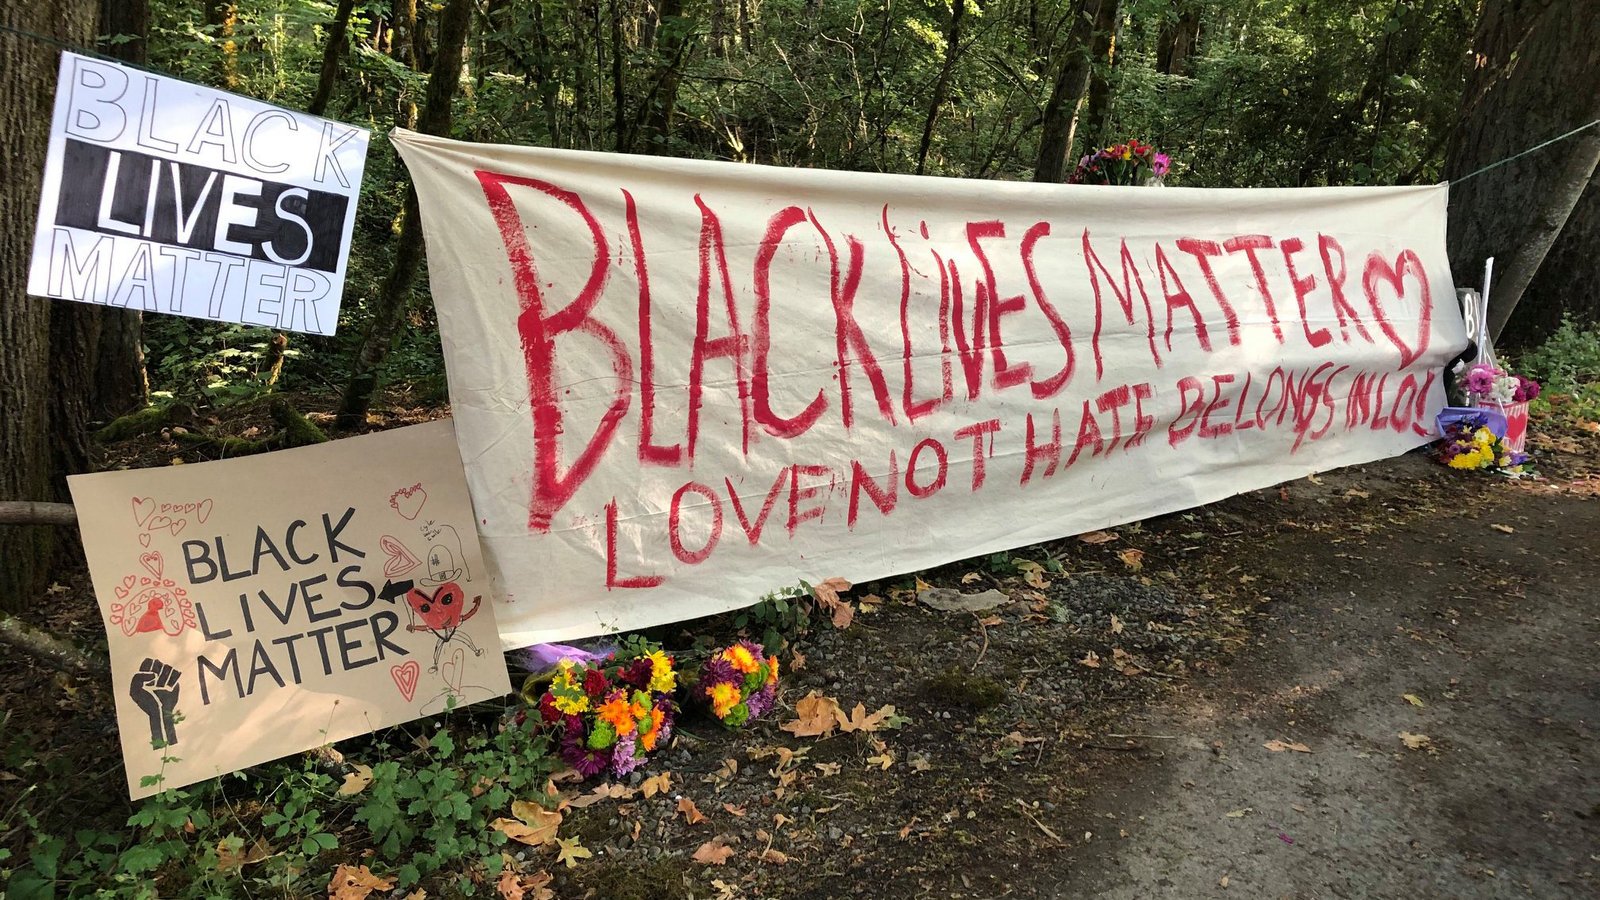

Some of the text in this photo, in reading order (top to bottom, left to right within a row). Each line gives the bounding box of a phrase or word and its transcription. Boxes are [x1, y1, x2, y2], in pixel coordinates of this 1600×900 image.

[65, 57, 359, 188] BLACK
[97, 150, 314, 267] LIVES
[47, 227, 331, 334] MATTER
[474, 169, 1375, 534] BLACK LIVES MATTER
[605, 462, 836, 591] LOVE
[847, 418, 1002, 532] NOT
[1019, 382, 1156, 487] HATE
[1168, 361, 1350, 455] BELONGS
[1344, 368, 1377, 433] IN
[182, 507, 366, 585] BLACK
[194, 565, 377, 642] LIVES
[197, 610, 410, 706] MATTER
